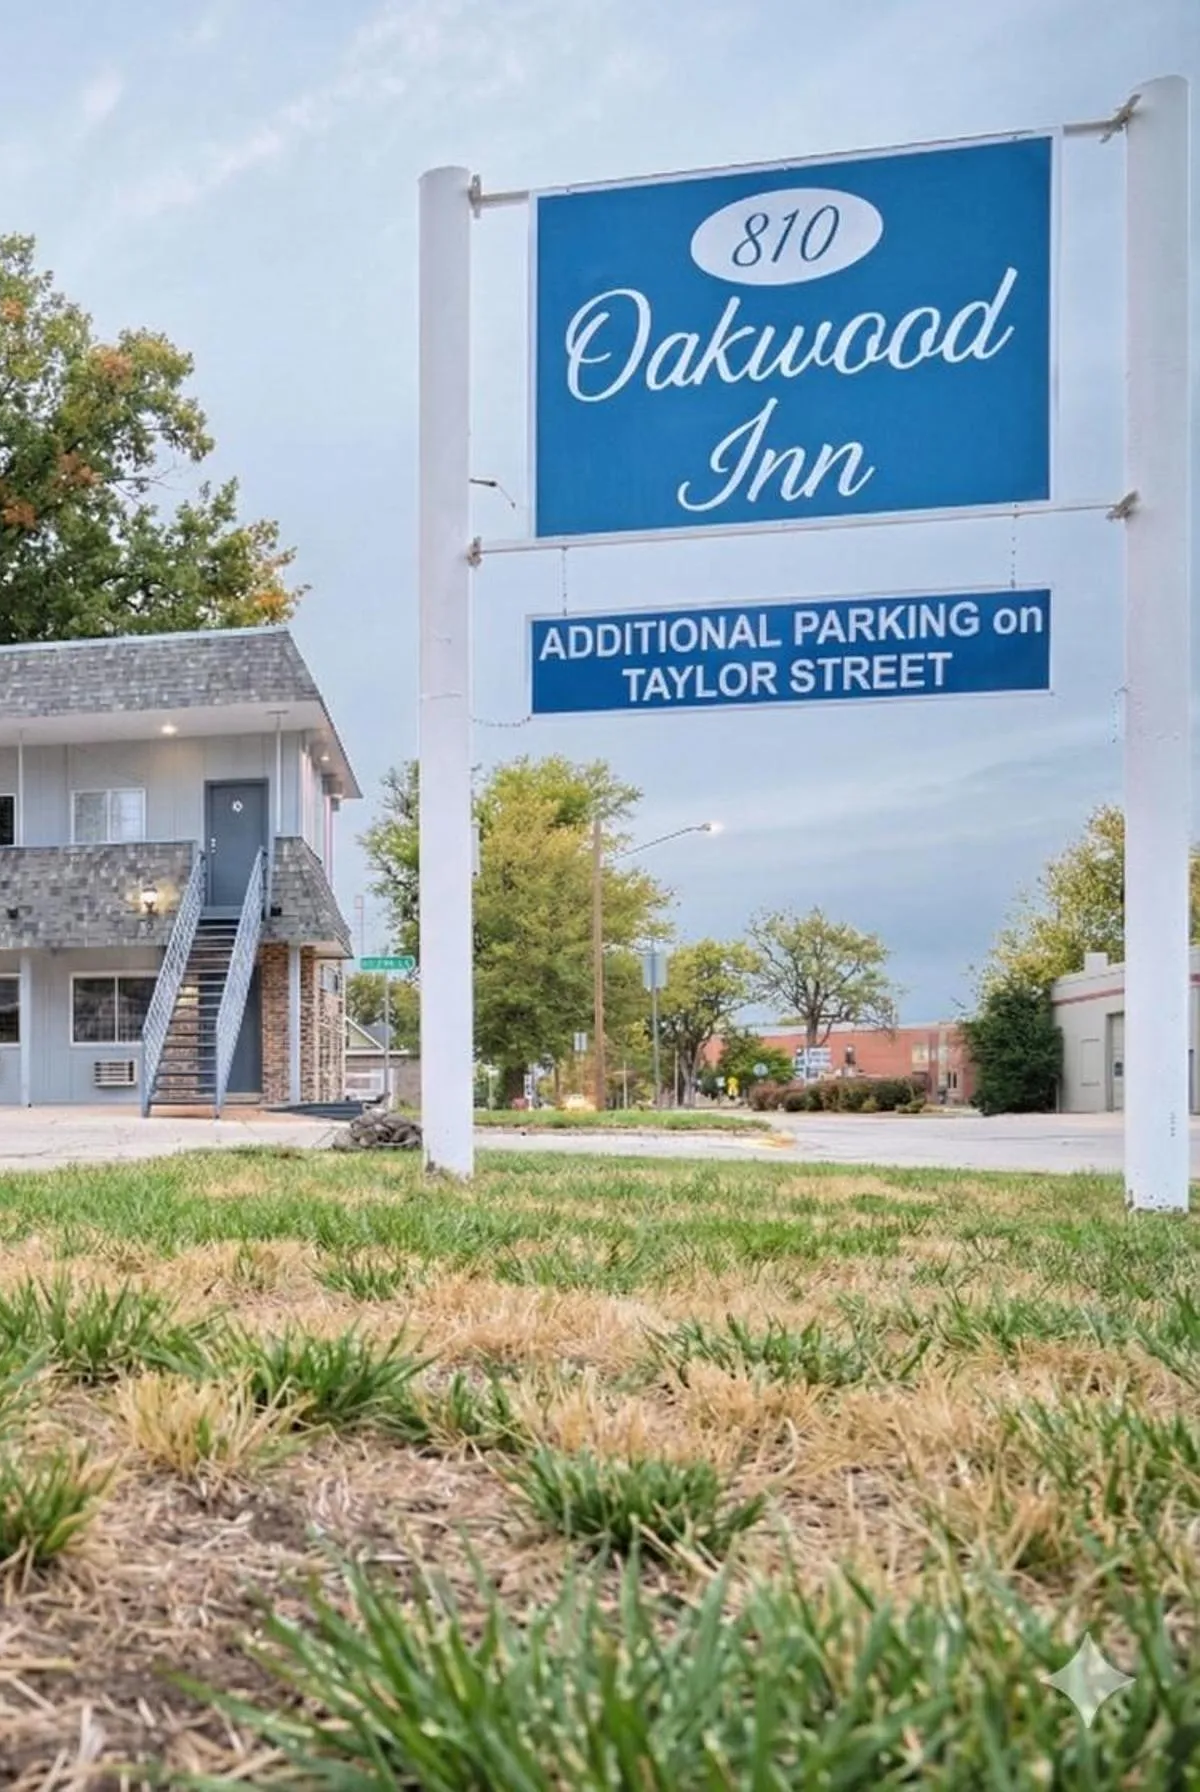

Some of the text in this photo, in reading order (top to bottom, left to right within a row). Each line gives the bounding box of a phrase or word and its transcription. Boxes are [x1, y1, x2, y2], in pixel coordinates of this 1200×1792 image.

[731, 204, 840, 268] 810
[565, 267, 1018, 402] Oakwood
[677, 397, 875, 512] Inn
[540, 601, 1043, 660] ADDITIONAL PARKING on
[622, 652, 953, 702] TAYLOR STREET
